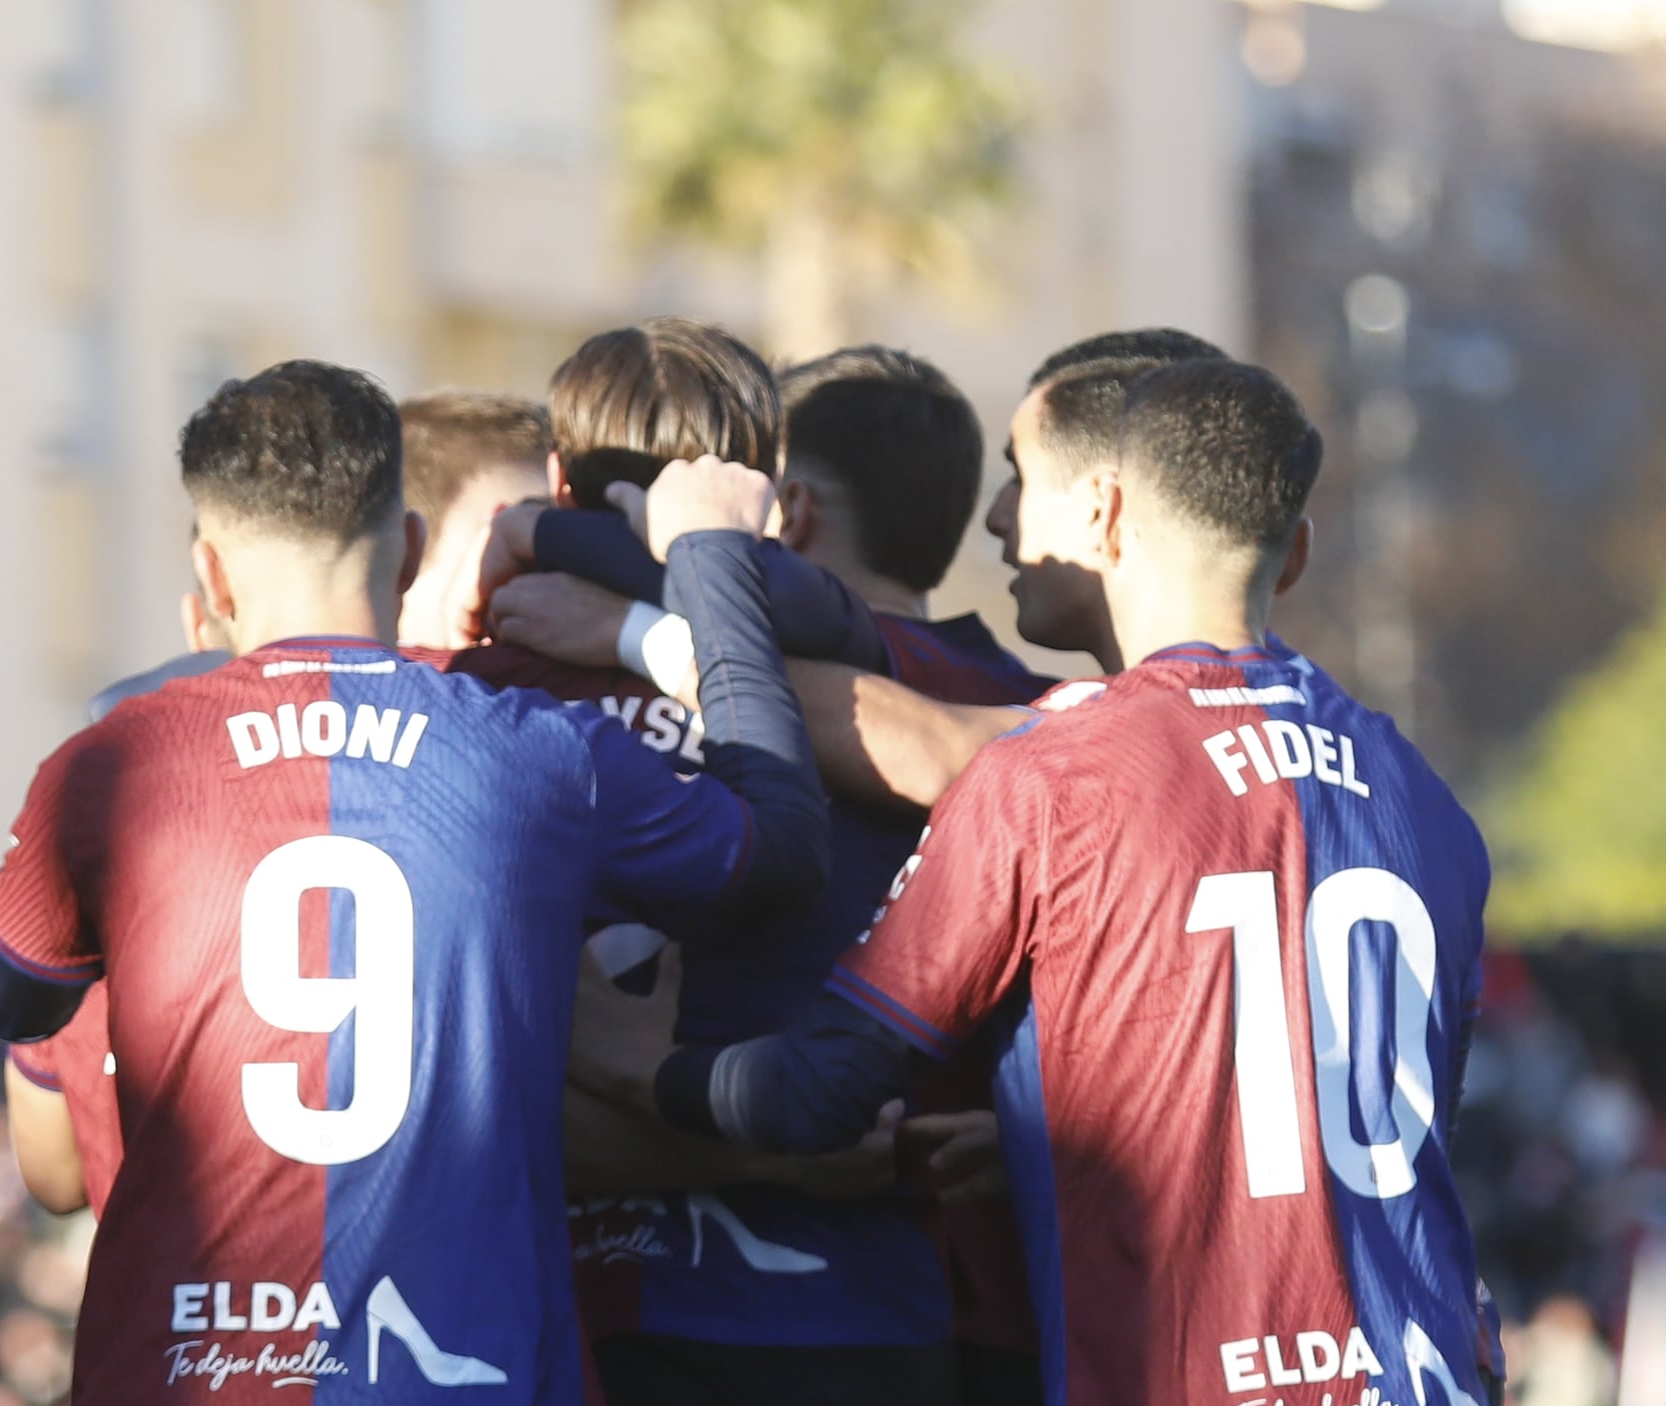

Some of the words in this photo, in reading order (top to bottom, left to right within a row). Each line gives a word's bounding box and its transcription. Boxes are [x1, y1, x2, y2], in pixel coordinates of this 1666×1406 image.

[226, 700, 429, 769] DIONI
[1202, 720, 1370, 798] FIDEL
[241, 835, 415, 1165] 9
[1185, 867, 1437, 1199] 10
[172, 1281, 341, 1332] ELDA
[164, 1340, 204, 1386] Te
[195, 1342, 255, 1391] deja
[1220, 1326, 1384, 1393] ELDA
